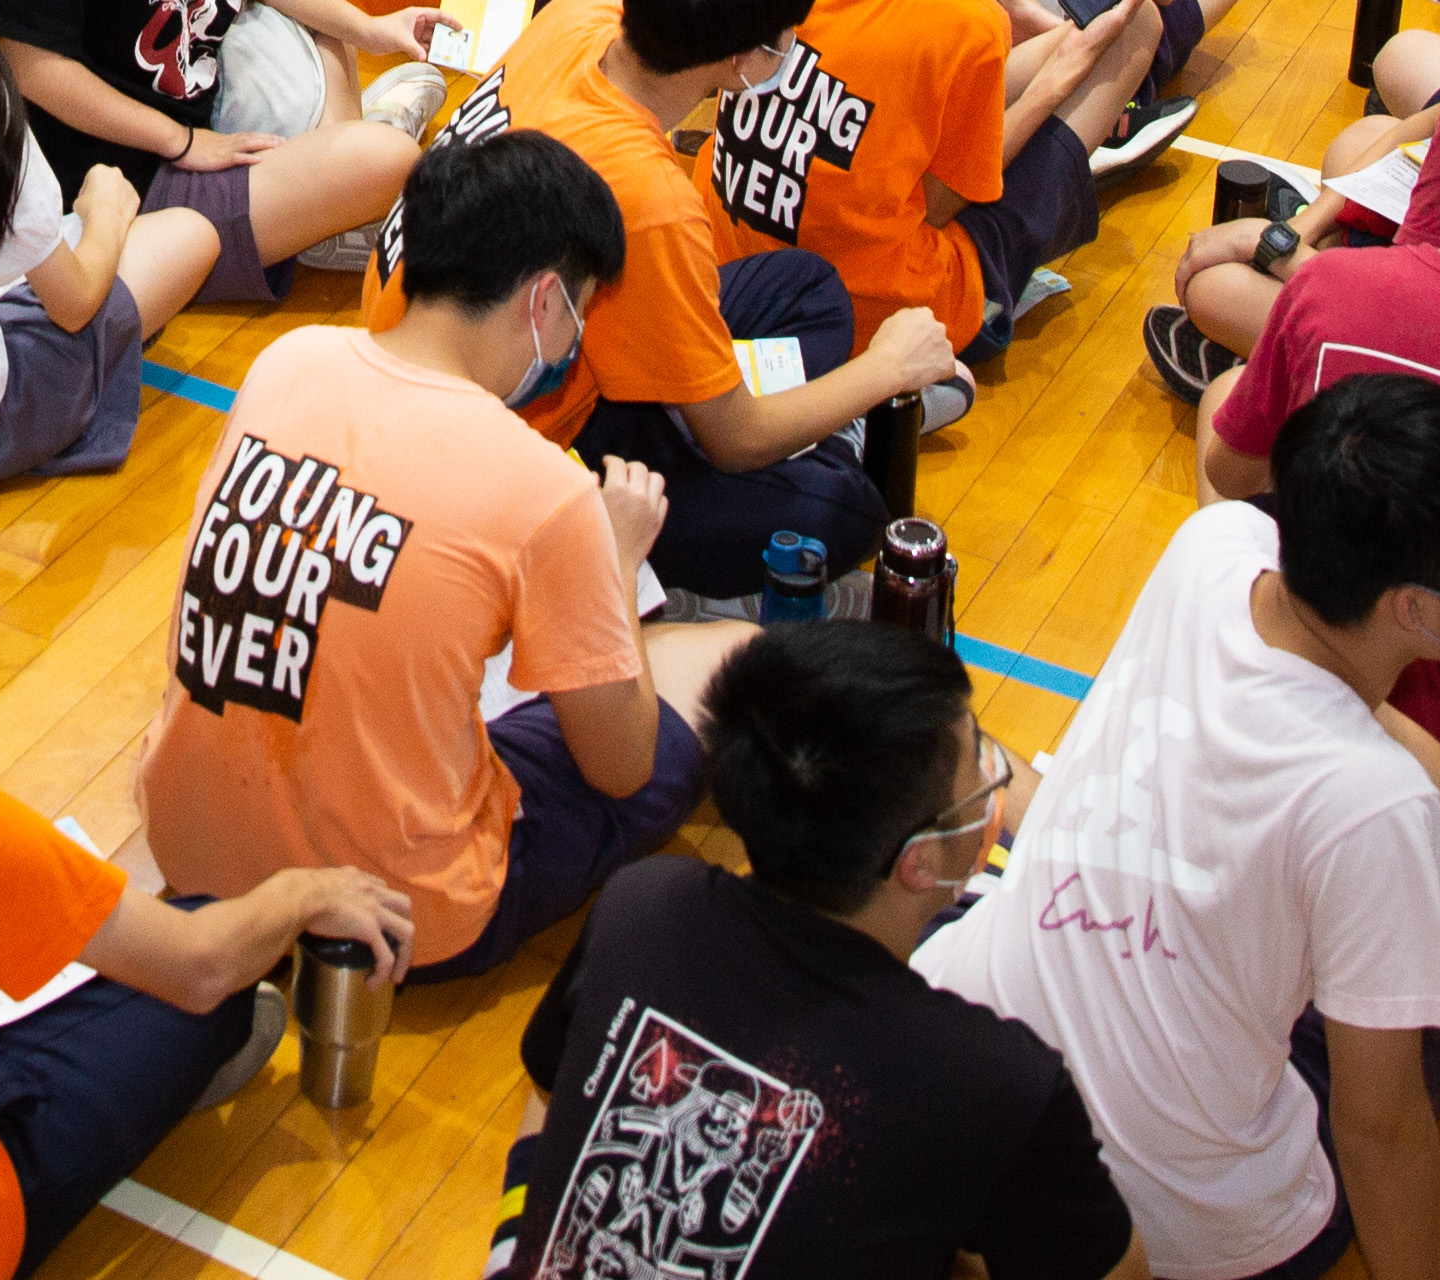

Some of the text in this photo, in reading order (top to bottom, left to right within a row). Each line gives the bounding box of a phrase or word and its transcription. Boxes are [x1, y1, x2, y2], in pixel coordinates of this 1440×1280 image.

[780, 43, 866, 151] UNG
[191, 501, 331, 625] FOUR
[218, 436, 401, 587] YOUNG
[179, 590, 310, 700] EVER
[584, 997, 636, 1096] Chung Ming
